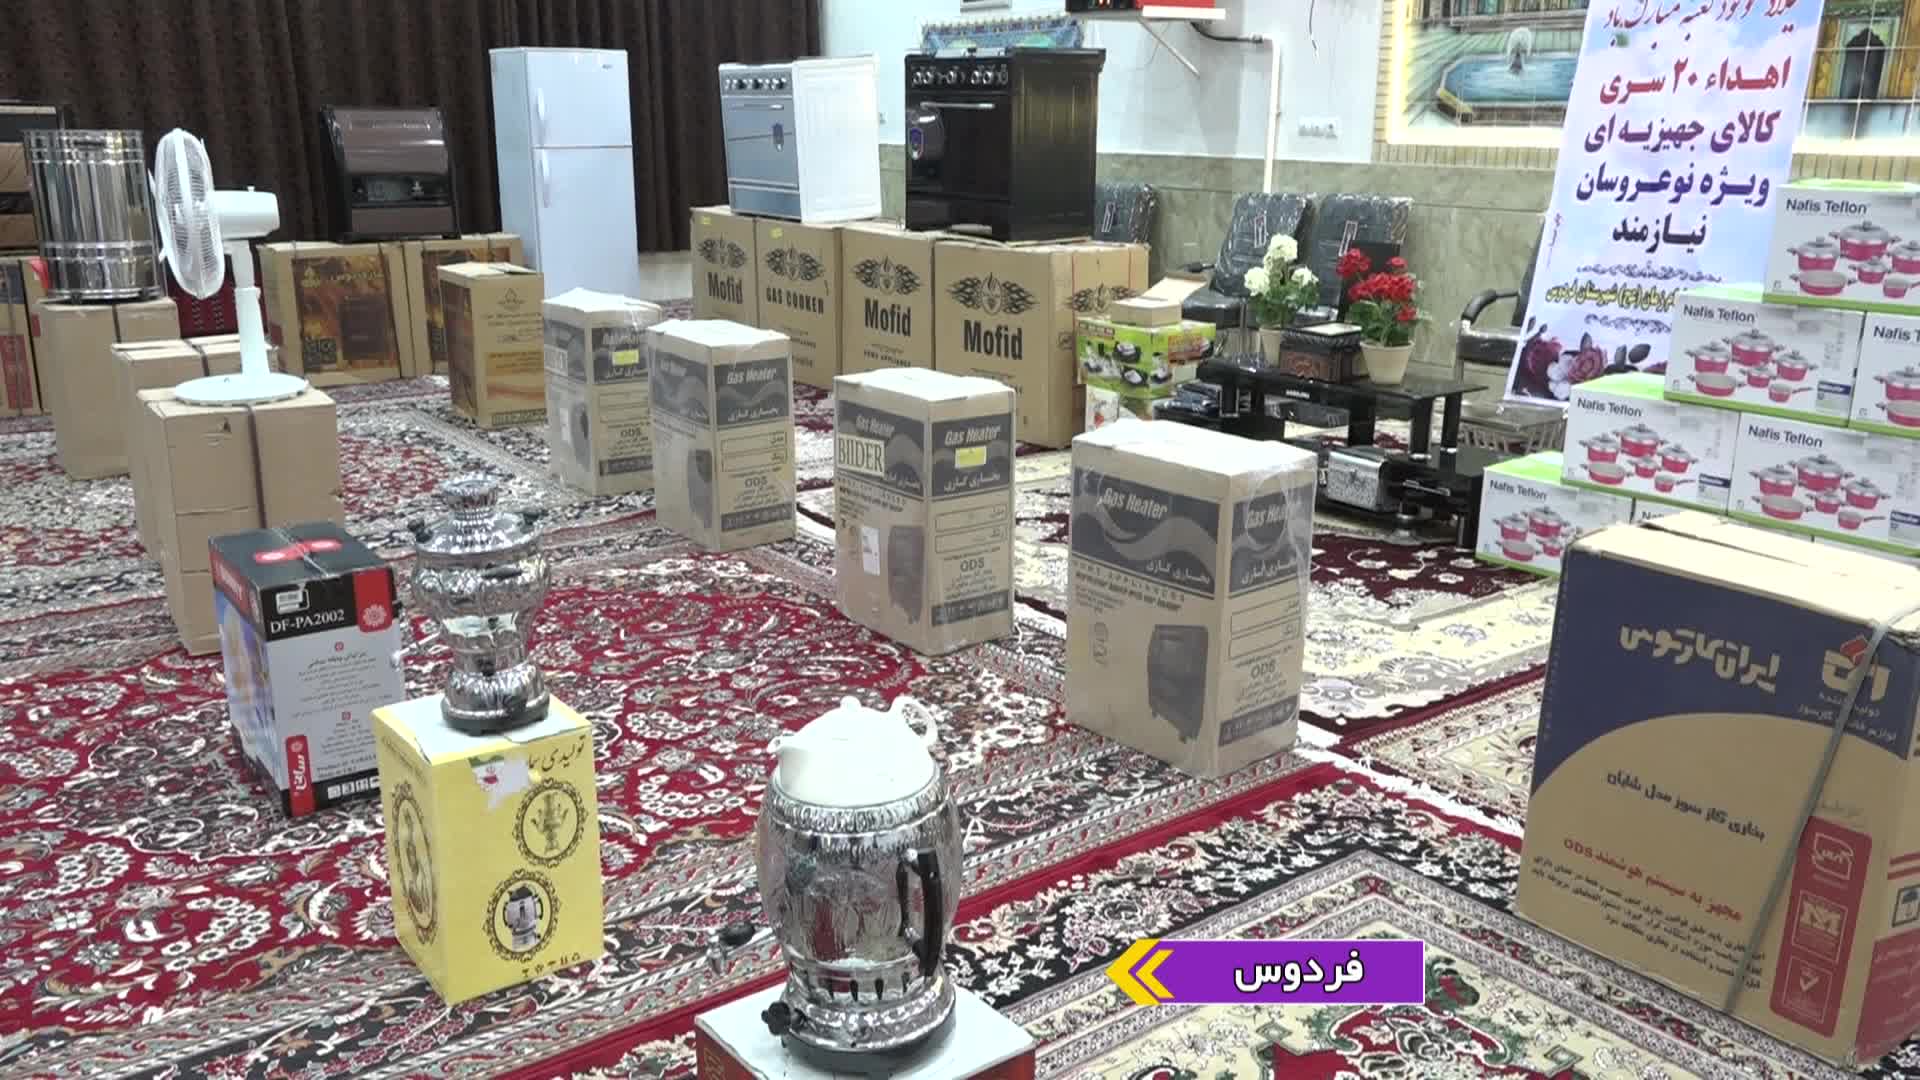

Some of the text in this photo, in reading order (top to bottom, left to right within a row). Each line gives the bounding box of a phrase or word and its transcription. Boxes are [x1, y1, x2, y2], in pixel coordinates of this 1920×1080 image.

[1600, 55, 1791, 104] اهداء ۲۰ سری
[1710, 109, 1782, 153] کالای
[1699, 165, 1770, 206] ویژه
[1786, 198, 1868, 215] Nafis Teflon
[1612, 211, 1707, 253] نیازمند
[708, 271, 744, 304] Mofid
[766, 287, 824, 315] GAS COOKER
[864, 297, 912, 337] Mofid
[1683, 304, 1756, 323] Nafis Teflon
[963, 319, 1024, 361] Mofid
[1873, 325, 1911, 341] Nafis
[1577, 397, 1643, 417] Nafis Teflon
[944, 424, 1001, 446] Gas Heater
[1748, 425, 1824, 448] Nafis Teflon
[1103, 487, 1168, 519] Gas Heater
[1490, 479, 1548, 501] Nafis Teflon
[960, 556, 985, 573] ODS
[270, 608, 346, 634] DF-PA2002
[1714, 640, 1781, 695] ایران
[542, 734, 587, 772] تولیدی
[1727, 820, 1767, 844] بخاری
[1563, 837, 1594, 859] ODS
